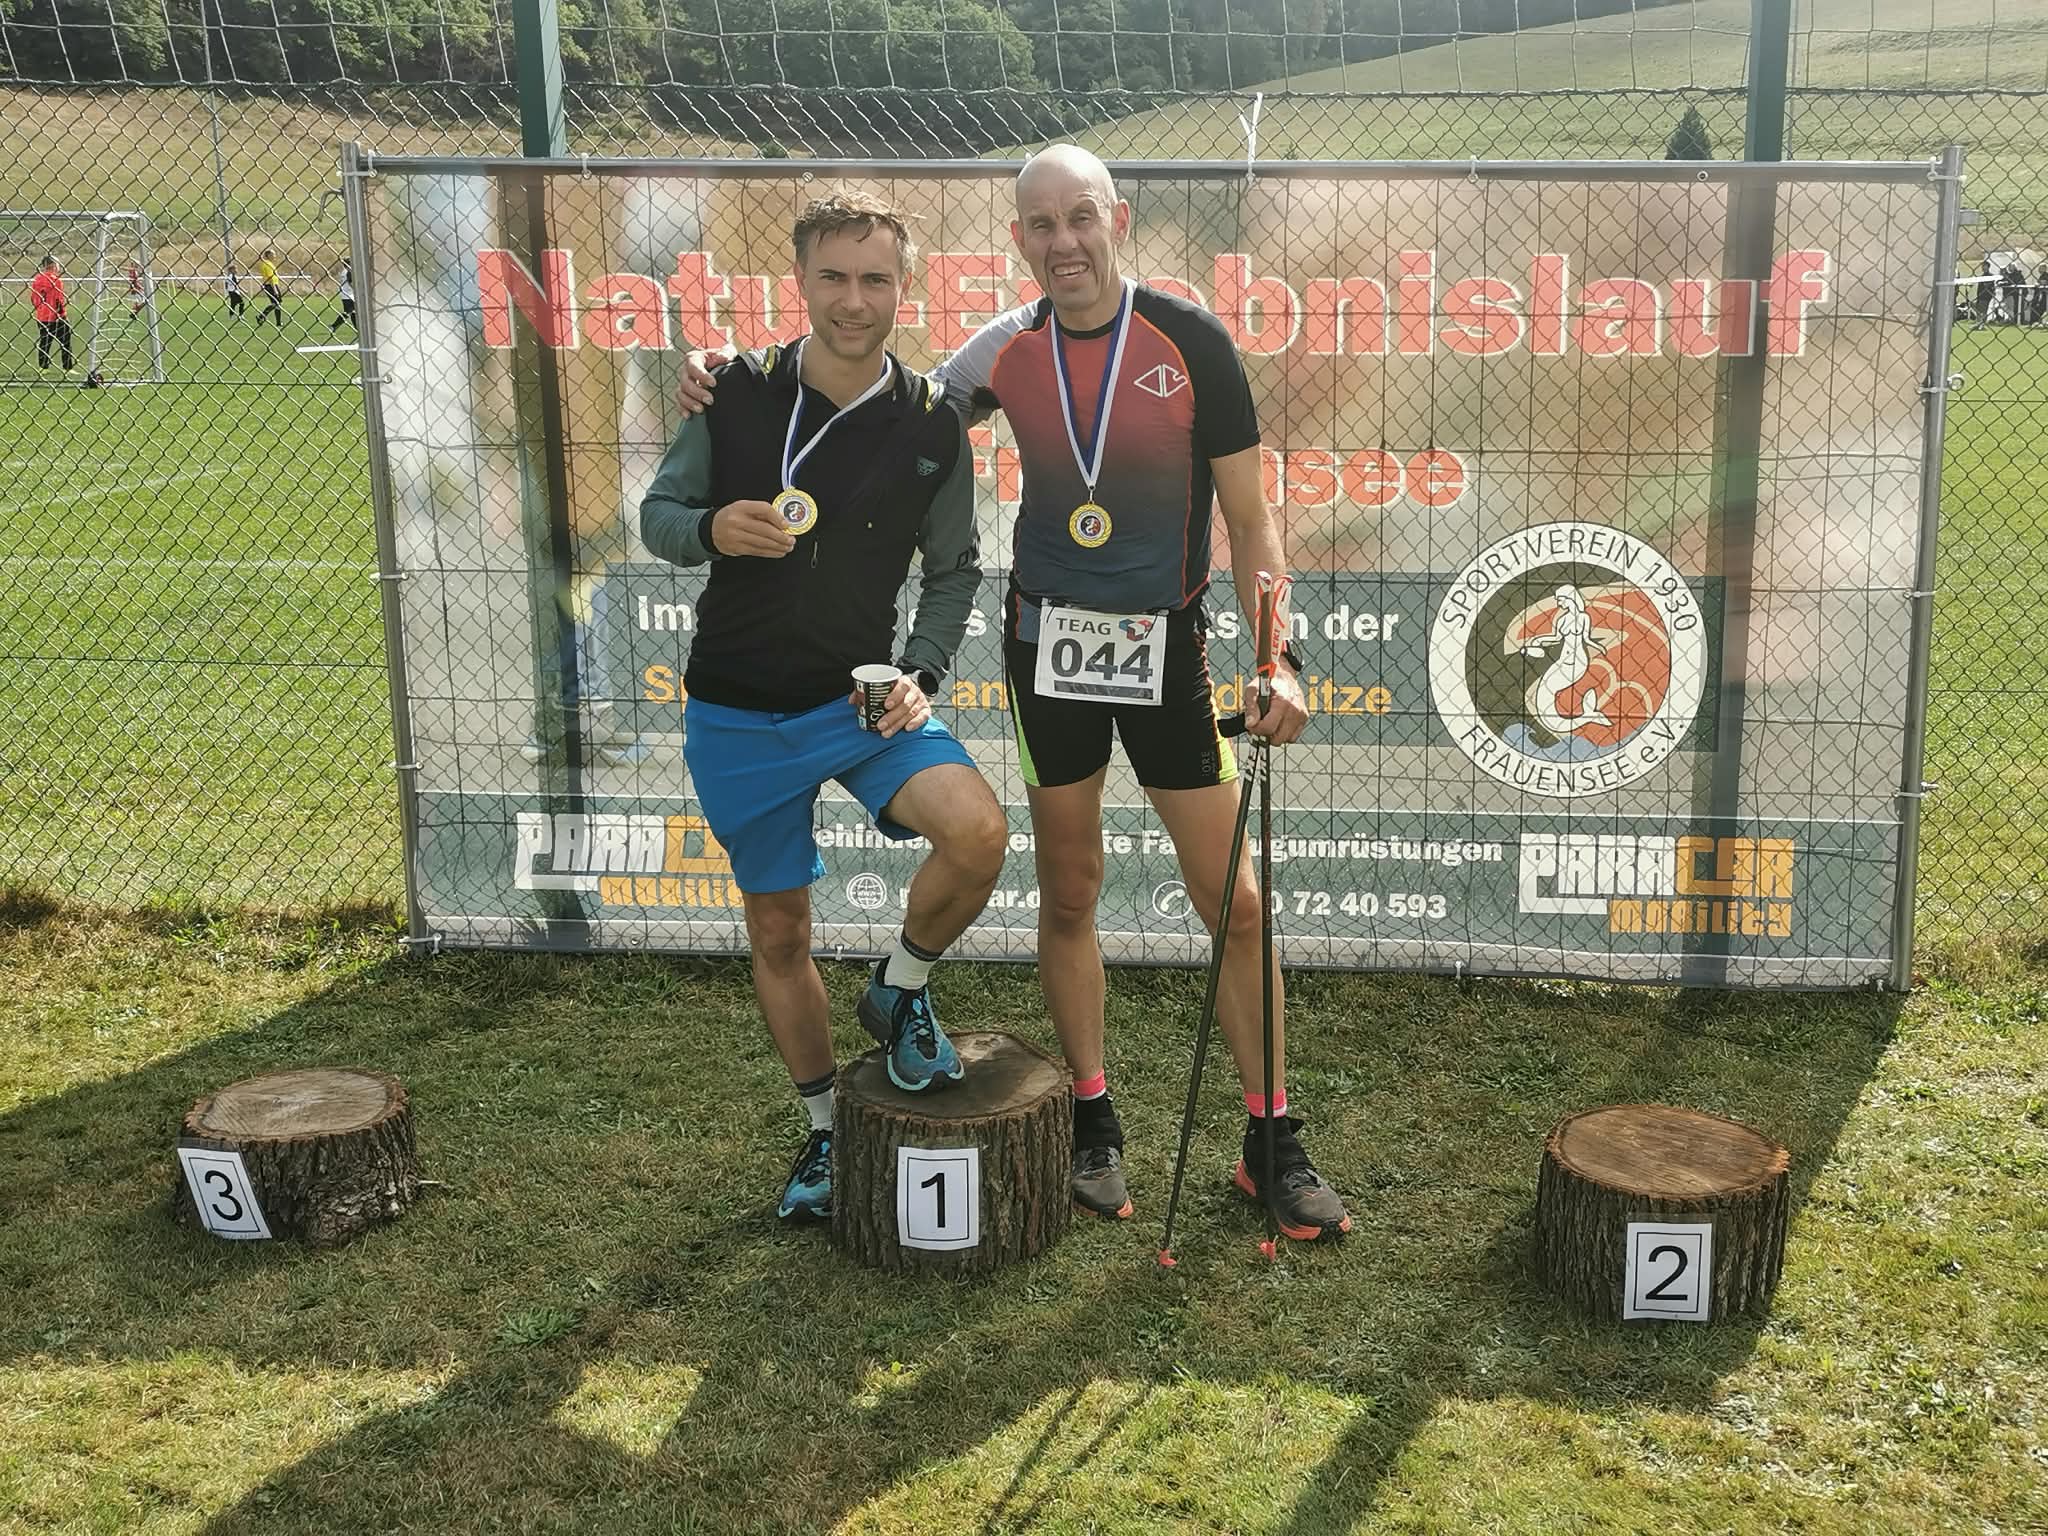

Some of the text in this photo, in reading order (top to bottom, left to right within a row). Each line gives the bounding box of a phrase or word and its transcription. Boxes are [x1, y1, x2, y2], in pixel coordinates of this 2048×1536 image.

[1442, 528, 1697, 632] SPORTVEREIN 1930
[638, 595, 692, 631] Im
[1324, 604, 1399, 642] der
[1055, 617, 1111, 636] TEAG
[1051, 637, 1153, 683] 044
[1459, 717, 1685, 793] FRAUENSEE e.V.
[1293, 891, 1331, 916] 72
[1340, 892, 1379, 917] 40
[1385, 893, 1447, 919] 593
[204, 1169, 243, 1222] 3
[921, 1172, 946, 1228] 1
[1645, 1245, 1689, 1301] 2
